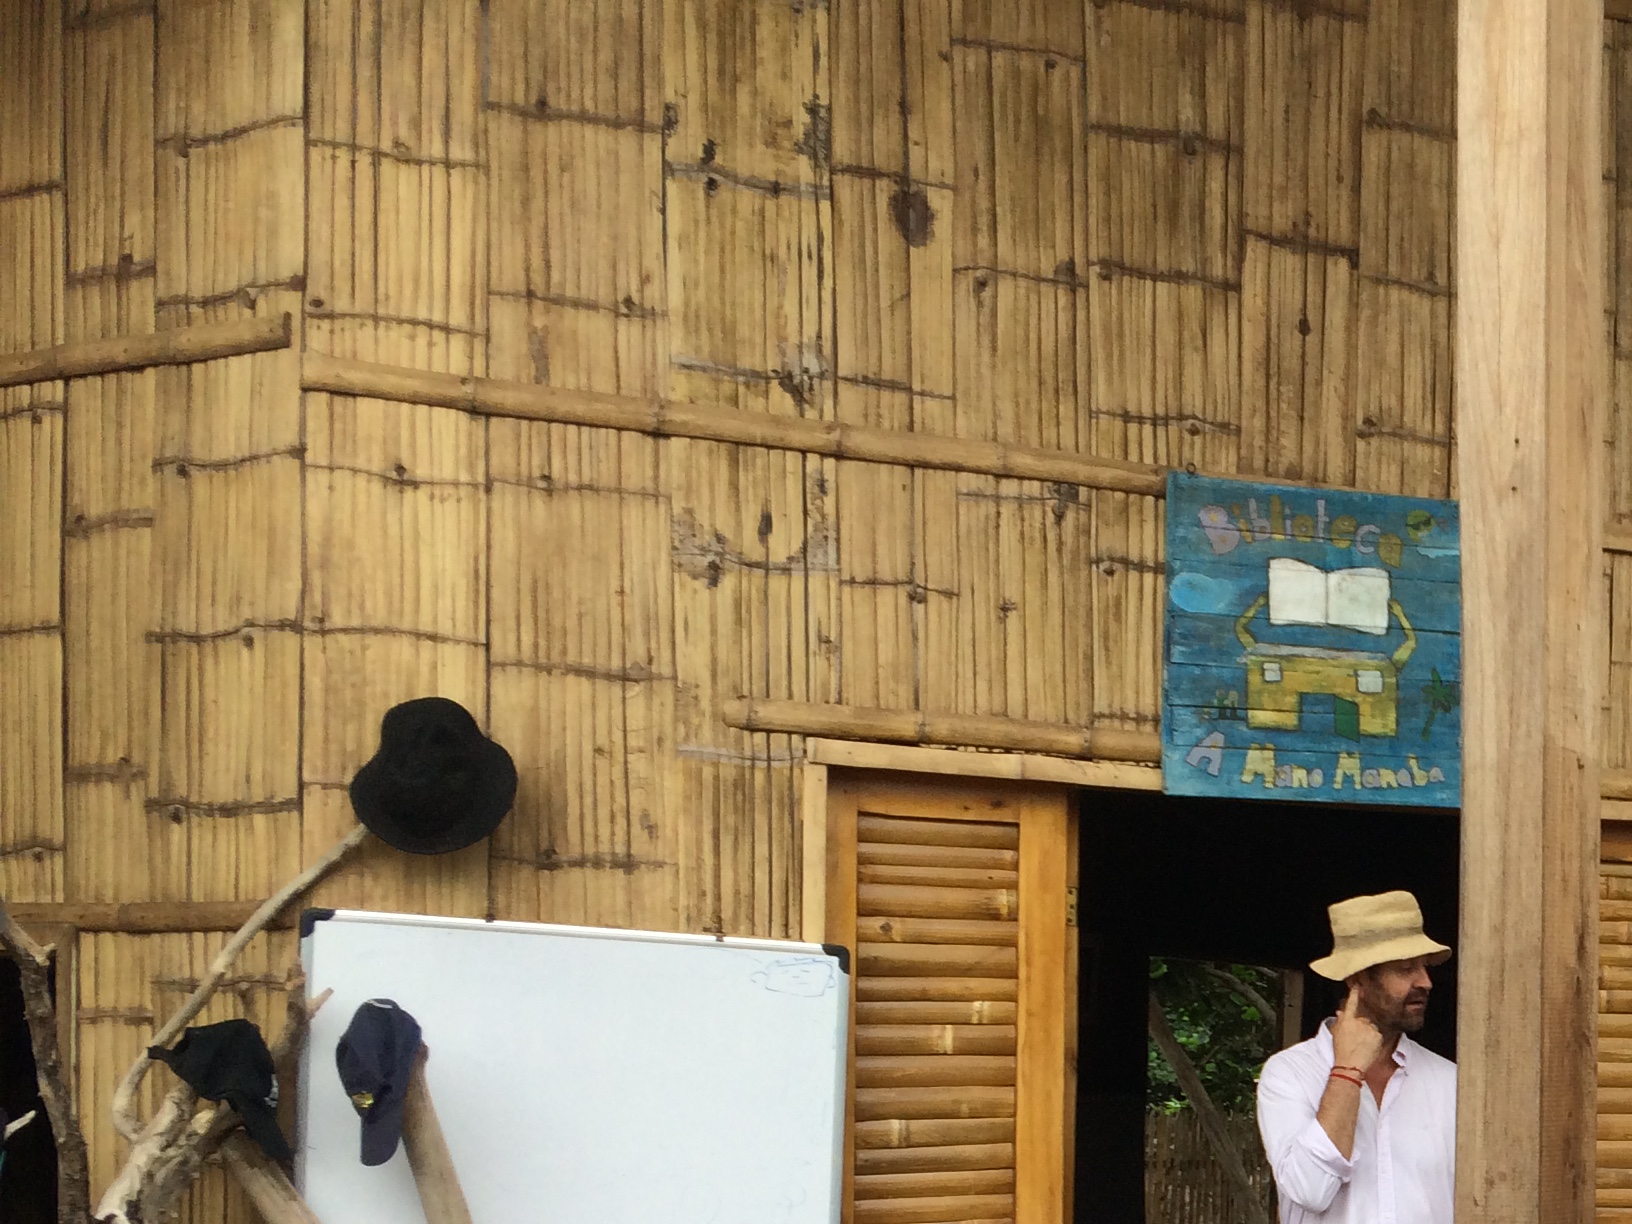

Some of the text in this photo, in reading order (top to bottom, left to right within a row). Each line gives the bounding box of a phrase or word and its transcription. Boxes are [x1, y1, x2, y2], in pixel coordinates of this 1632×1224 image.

[1198, 495, 1404, 568] Biblioteca
[1185, 731, 1446, 790] A Mano Manaba
